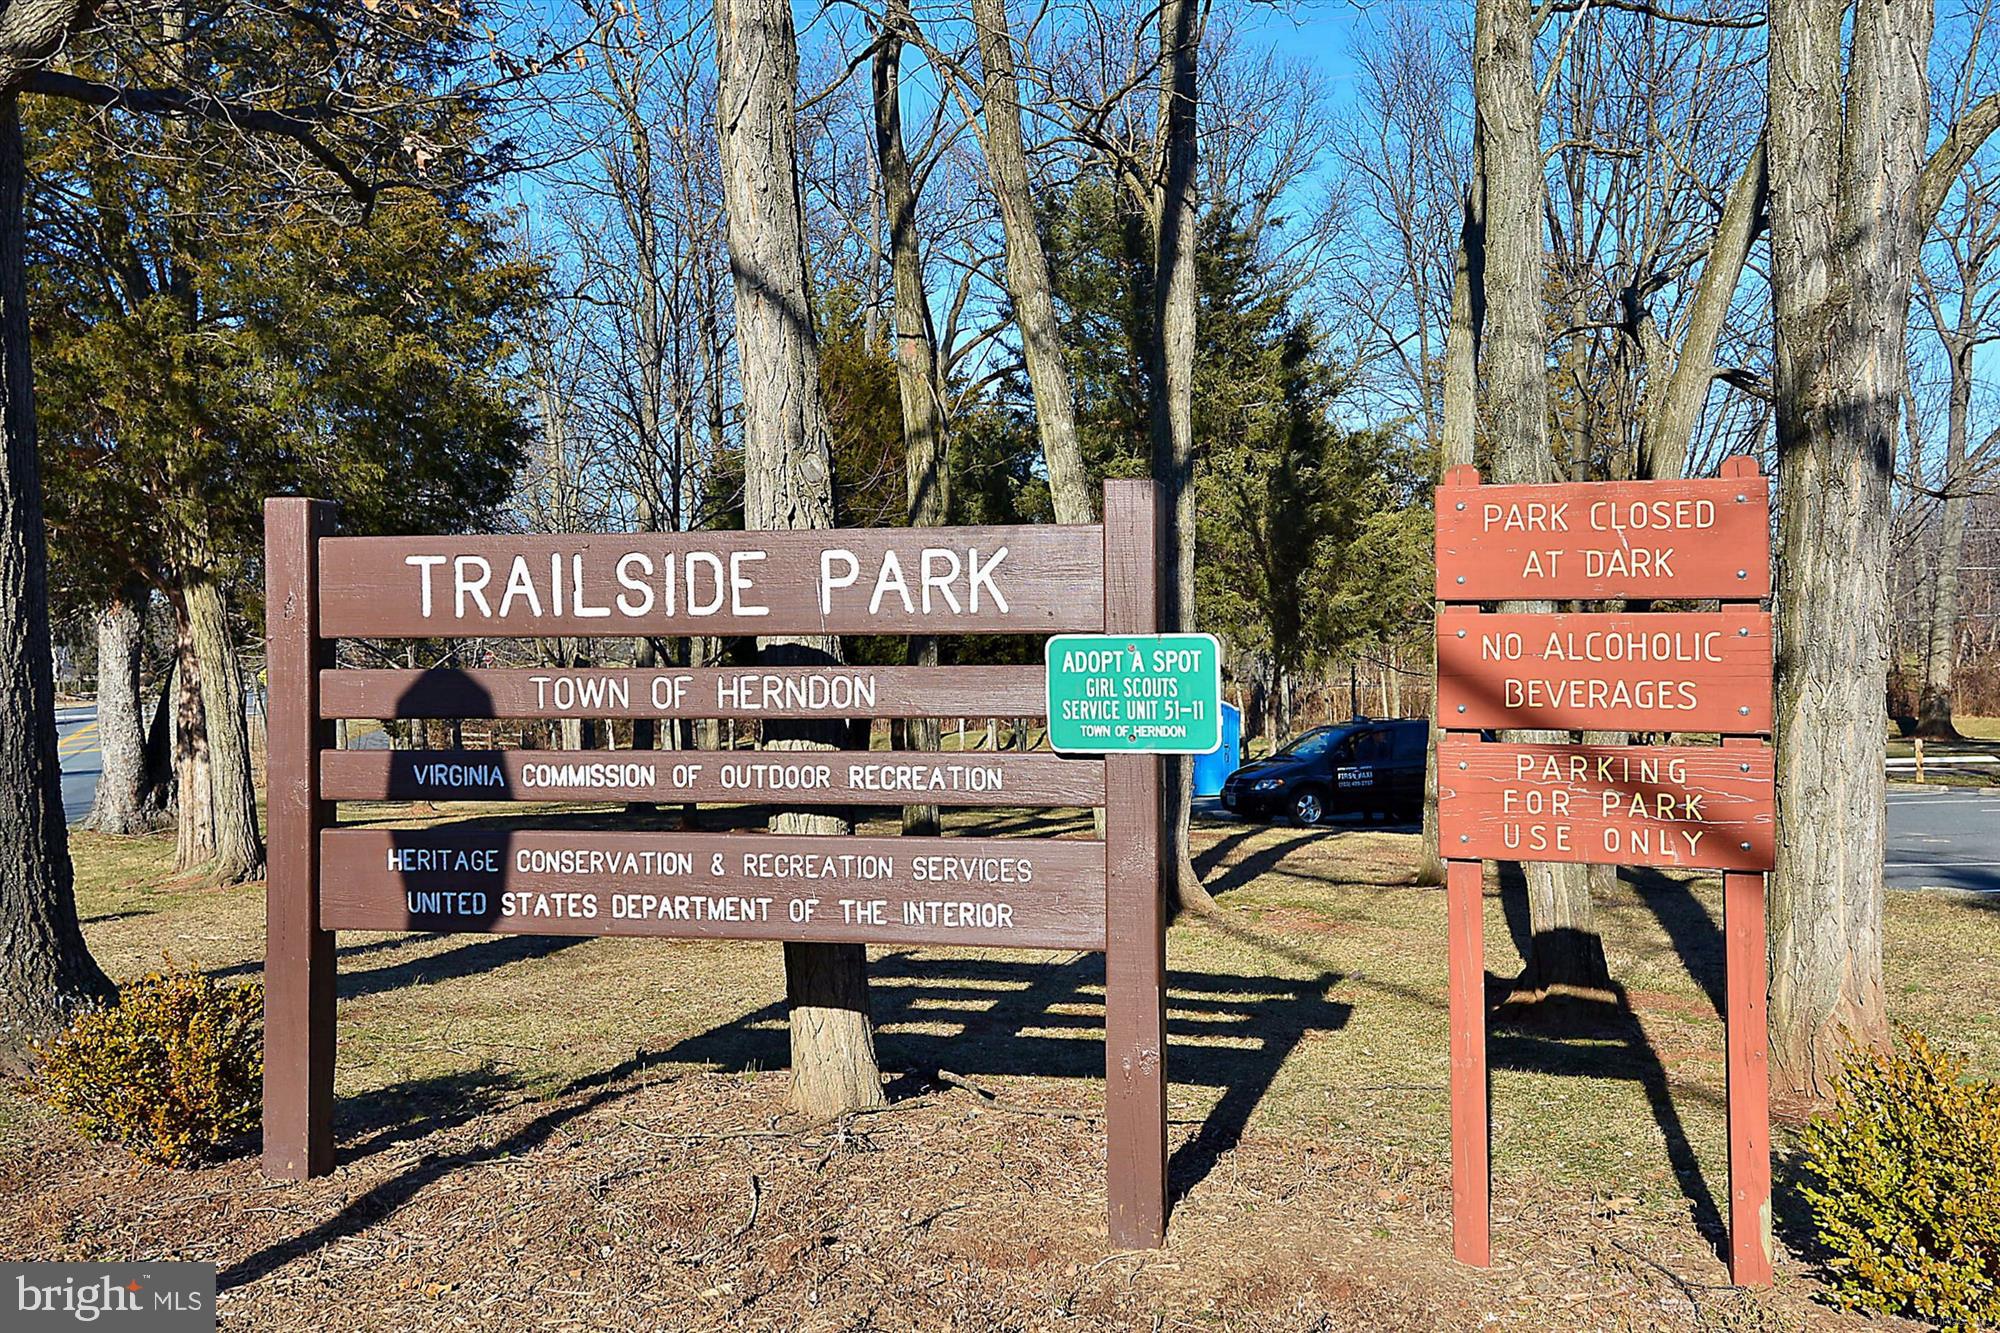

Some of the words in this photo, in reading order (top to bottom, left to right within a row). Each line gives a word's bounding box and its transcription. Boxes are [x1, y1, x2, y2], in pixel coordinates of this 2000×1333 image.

[1484, 503, 1569, 532] PARK
[1590, 500, 1715, 530] CLOSED
[1522, 549, 1564, 578] AT
[1586, 548, 1674, 578] DARK
[405, 551, 770, 618] TRAILSIDE
[822, 546, 1009, 615] PARK
[1062, 650, 1124, 673] ADOPT
[1131, 650, 1145, 672] A
[1153, 649, 1202, 673] SPOT
[1482, 633, 1522, 661] NO
[1543, 631, 1722, 662] ALCOHOLIC
[528, 676, 629, 710] TOWN
[651, 675, 694, 710] OF
[717, 674, 876, 710] HERNDON
[1086, 678, 1118, 698] GIRL
[1123, 677, 1178, 698] SCOUTS
[1505, 679, 1697, 710] BEVERAGES
[1062, 700, 1120, 720] SERVICE
[1127, 700, 1158, 720] UNIT
[1164, 700, 1204, 720] 51-11
[1081, 725, 1111, 737] TOWN
[1115, 725, 1130, 737] OF
[1133, 725, 1186, 737] HERNDON
[413, 763, 505, 787] VIRGINIA
[522, 763, 655, 788] COMMISSION
[672, 764, 703, 788] OF
[720, 764, 831, 790] OUTDOOR
[849, 765, 1003, 791] RECREATION
[1516, 753, 1686, 784] PARKING
[1503, 789, 1570, 816] FOR
[1602, 789, 1703, 821] PARK
[1504, 823, 1571, 851] USE
[1604, 827, 1703, 857] ONLY
[387, 848, 499, 872] HERITAGE
[516, 849, 692, 876] CONSERVATION
[710, 853, 725, 876] &
[743, 853, 893, 880] RECREATION
[912, 856, 1032, 883] SERVICES
[407, 891, 487, 915] UNITED
[501, 892, 598, 918] STATES
[612, 894, 773, 921] DEPARTMENT
[789, 898, 820, 923] OF
[838, 899, 888, 925] THE
[903, 900, 1014, 928] INTERIOR
